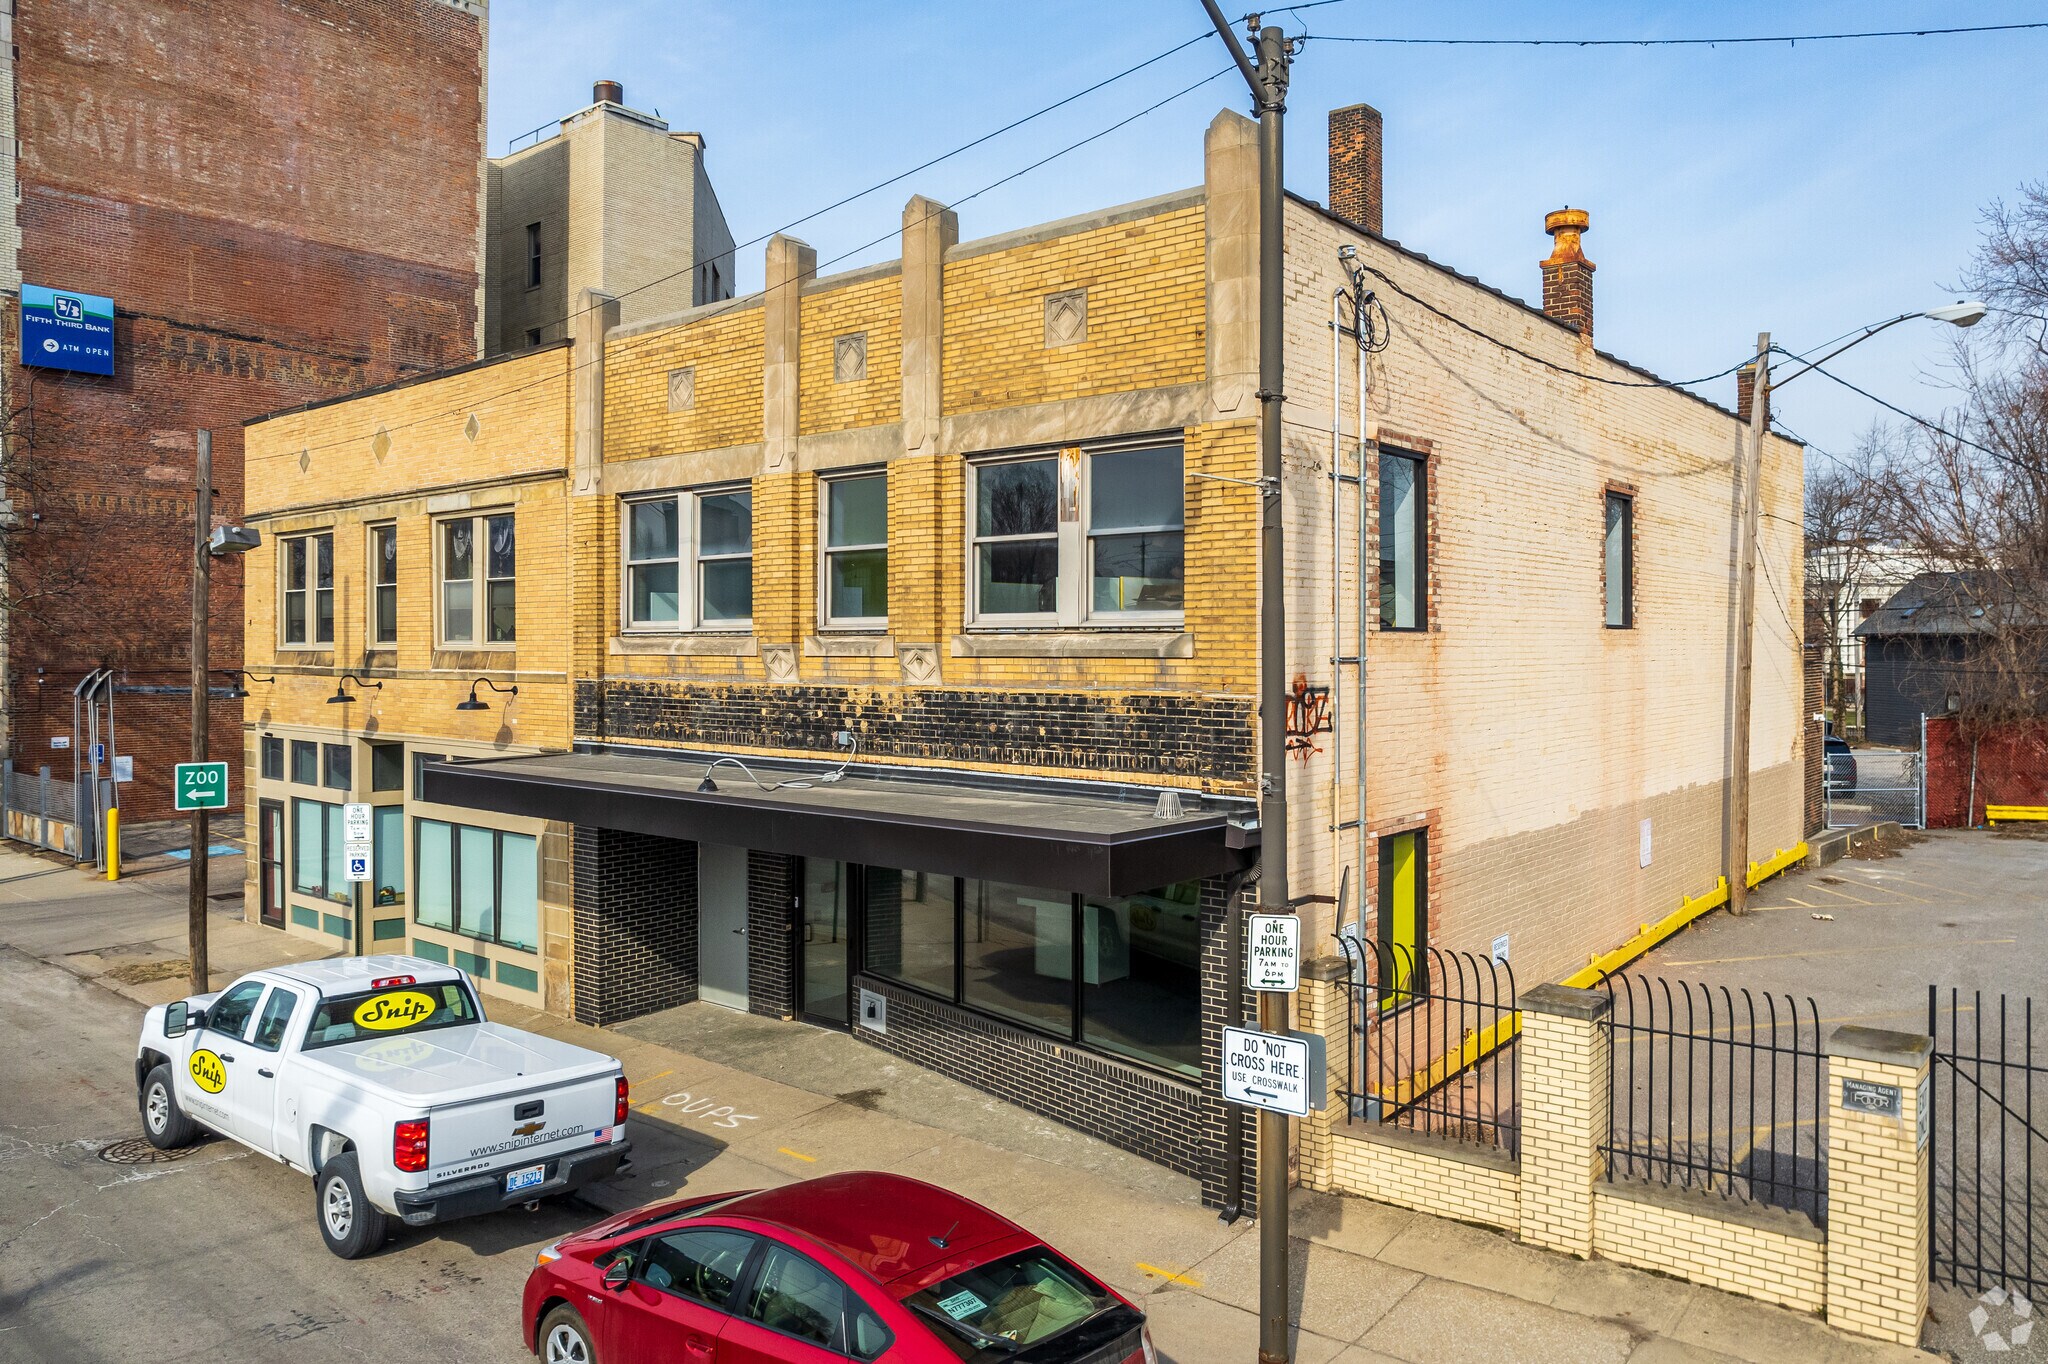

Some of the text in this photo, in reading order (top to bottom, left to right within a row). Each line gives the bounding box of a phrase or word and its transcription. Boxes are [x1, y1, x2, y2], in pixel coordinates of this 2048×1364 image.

[25, 314, 110, 333] FIFTH THIRD BANK
[62, 344, 109, 356] ATM OPEN
[185, 770, 218, 785] ZOO
[1265, 923, 1284, 934] ONE
[1261, 935, 1287, 945] HOUR
[1254, 946, 1293, 958] PARKING
[1259, 958, 1276, 967] 7AM
[1265, 969, 1283, 977] 6PM
[362, 998, 428, 1022] Snip
[1244, 1038, 1286, 1059] DO NOT
[192, 1056, 222, 1088] Snip
[1231, 1052, 1300, 1079] CROSS HERE
[1232, 1071, 1298, 1093] USE CROSSWALK
[1846, 1081, 1898, 1096] MANAGING AGENT
[662, 1093, 759, 1128] OUPS
[470, 1124, 584, 1157] www.snipinternet.com
[436, 1162, 490, 1179] SILVERADO
